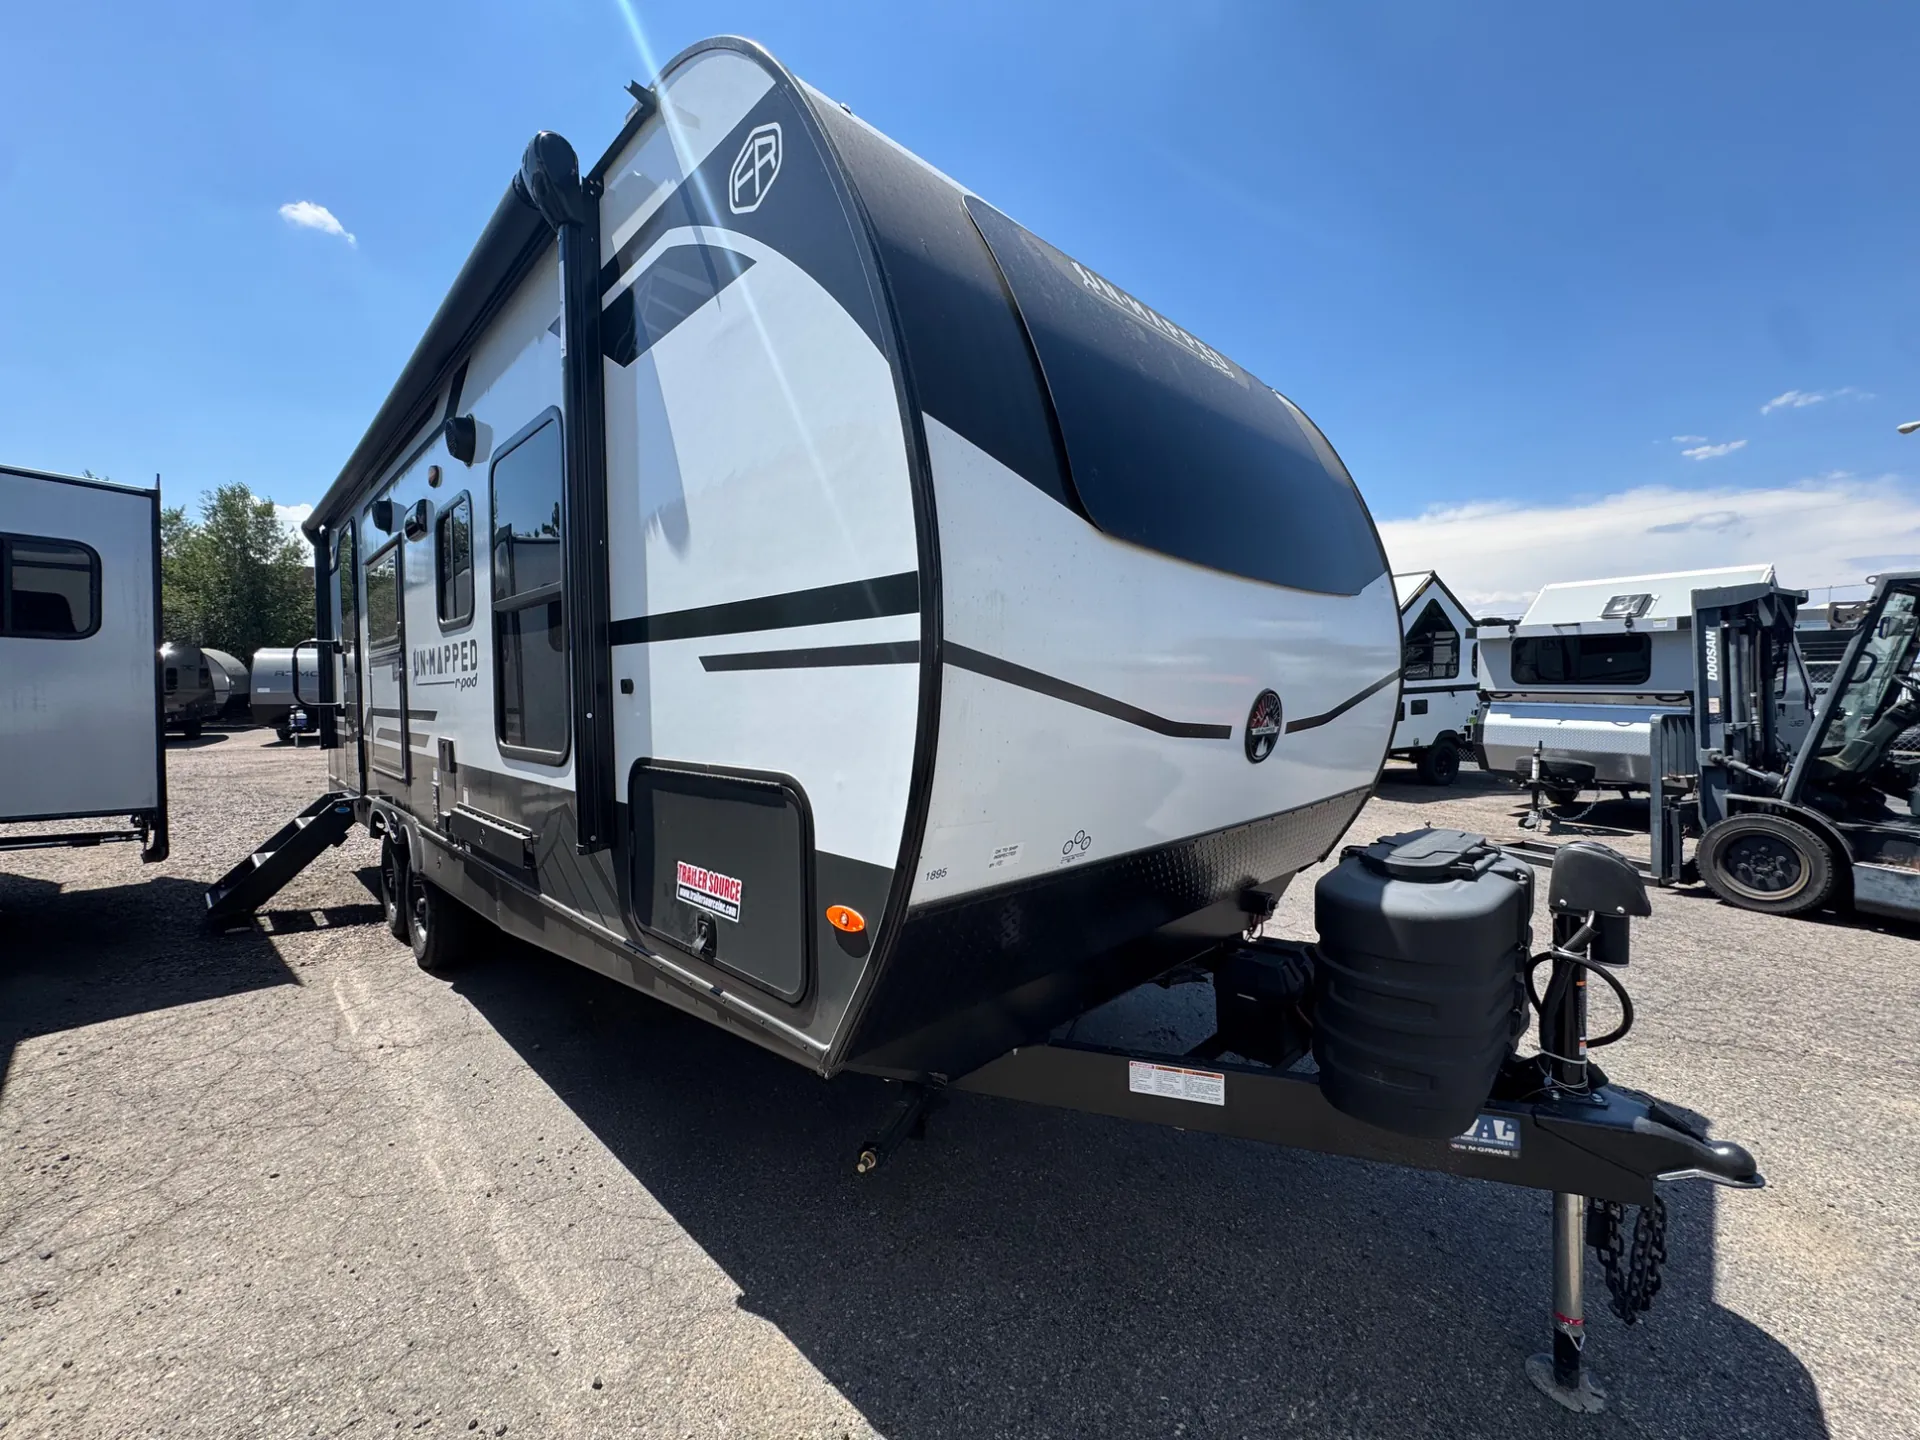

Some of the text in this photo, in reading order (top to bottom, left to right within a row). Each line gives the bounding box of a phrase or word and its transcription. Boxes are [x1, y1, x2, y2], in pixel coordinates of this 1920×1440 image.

[1705, 630, 1718, 681] DOOSAN
[678, 863, 741, 902] TRAILER SOURCE
[925, 867, 948, 881] 1895
